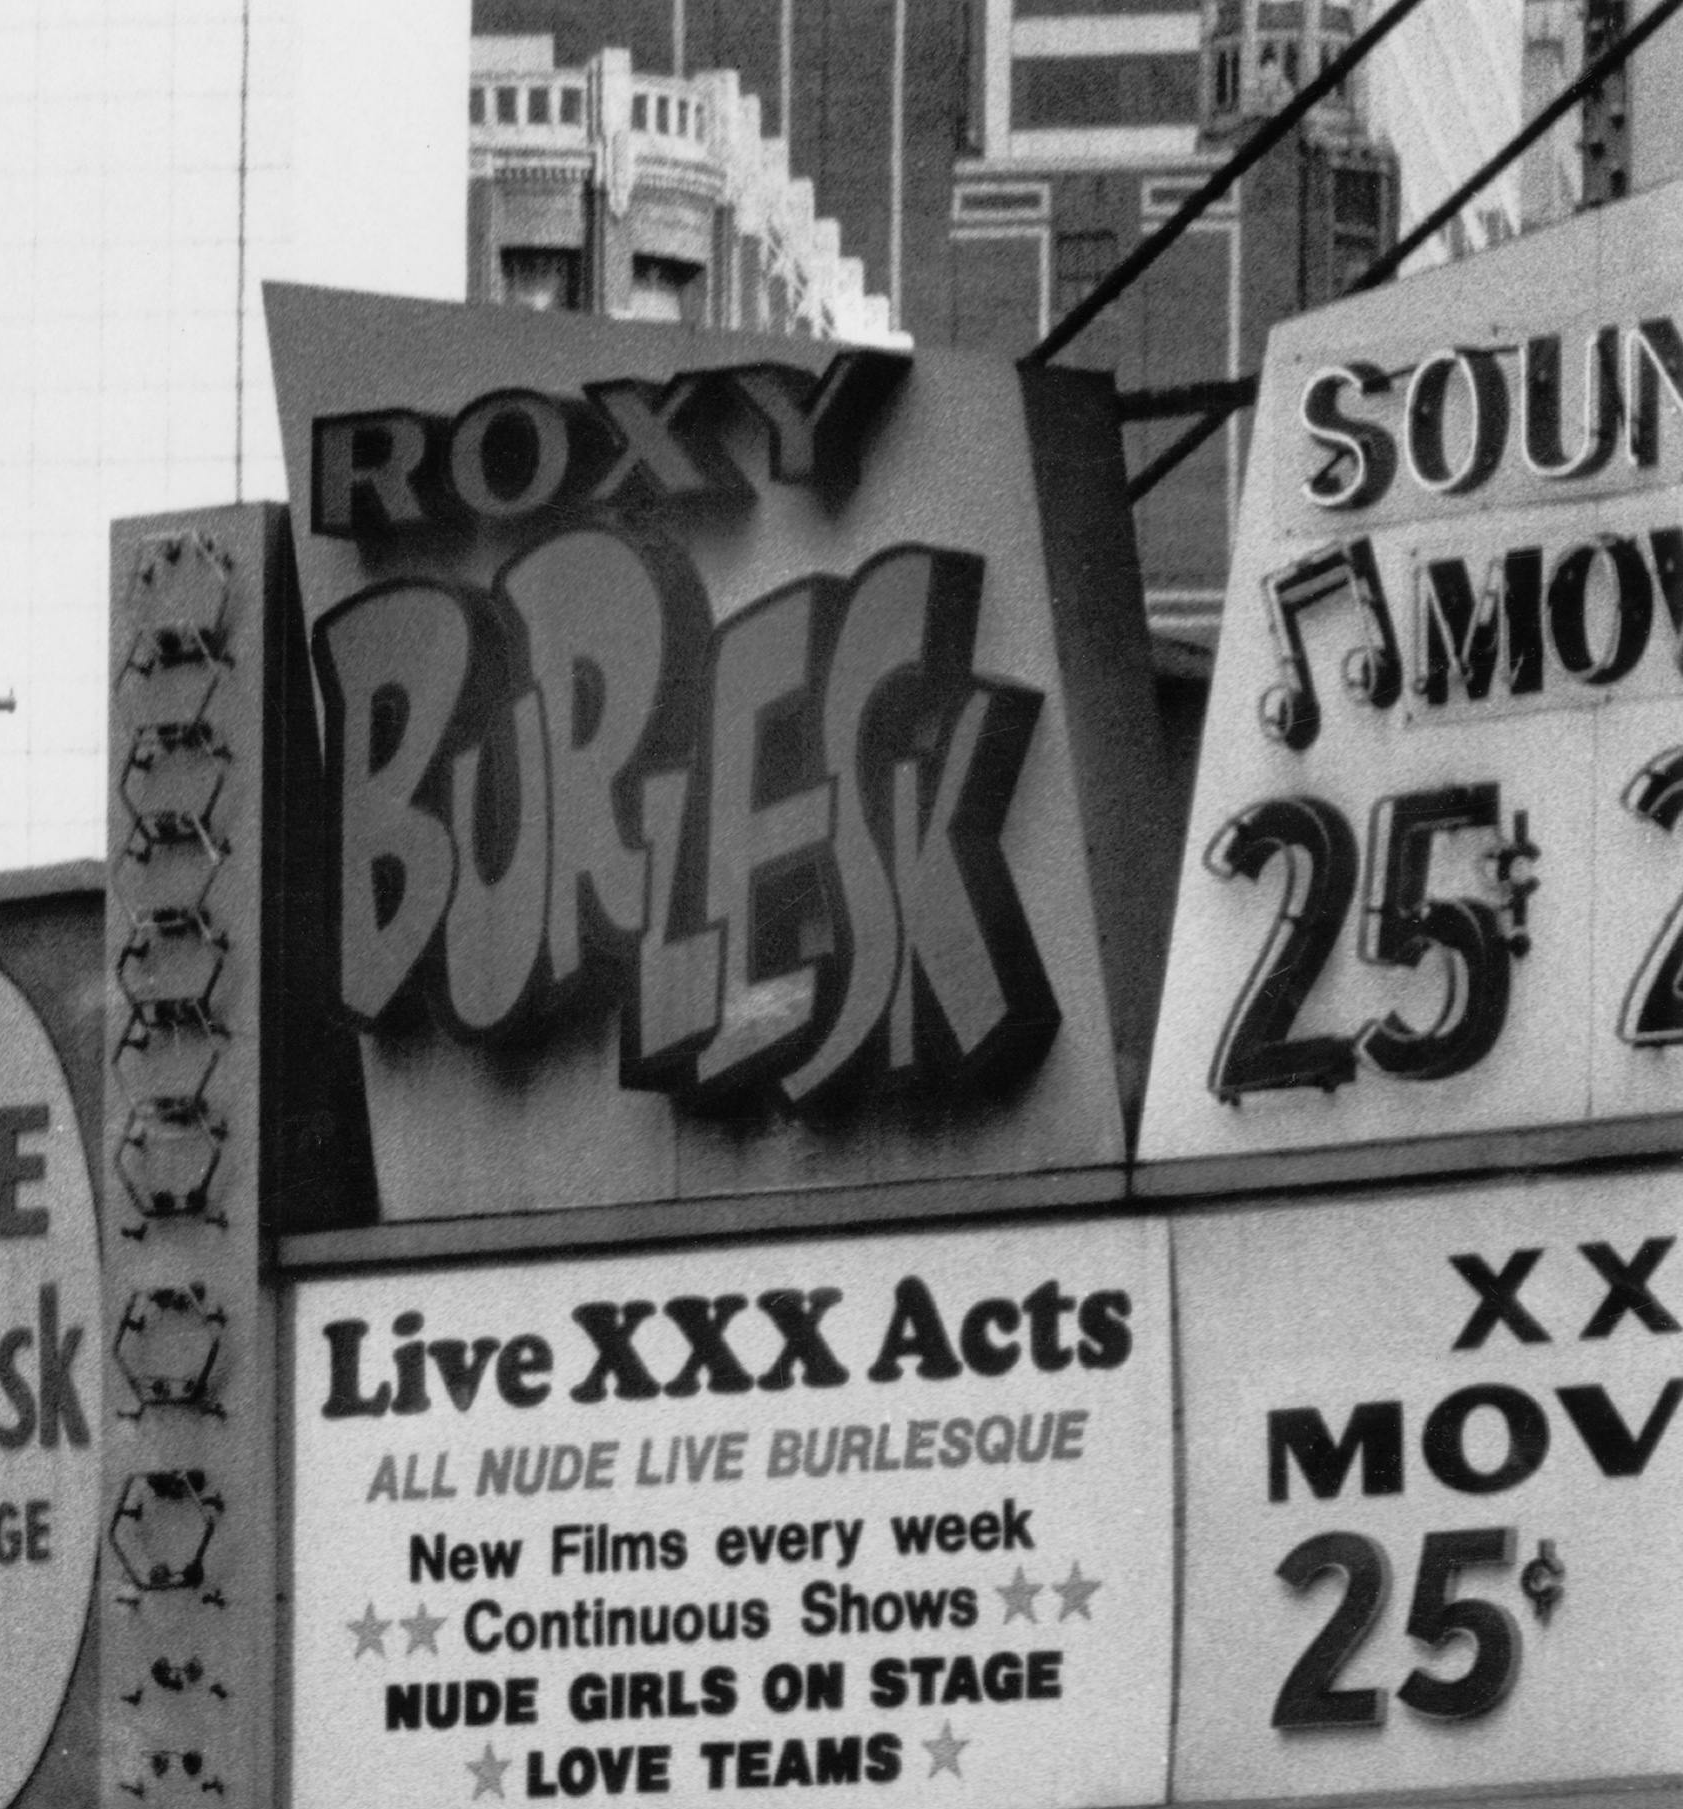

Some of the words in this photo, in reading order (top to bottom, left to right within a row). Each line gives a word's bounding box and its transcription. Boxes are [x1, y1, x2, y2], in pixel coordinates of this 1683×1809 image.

[311, 350, 914, 540] ROXY
[311, 530, 1063, 1100] BURLESK
[321, 1311, 553, 1420] Live
[569, 1287, 848, 1403] XXX
[866, 1274, 1133, 1382] Acts
[366, 1454, 458, 1503] ALL
[476, 1441, 618, 1497] NUDE
[636, 1430, 748, 1485] LIVE
[768, 1409, 1089, 1480] BURLESQUE
[1267, 1377, 1683, 1503] MOV
[409, 1532, 522, 1583] New
[551, 1523, 687, 1577] Films
[715, 1514, 862, 1570] every
[890, 1499, 1034, 1555] week
[463, 1587, 770, 1652] Continuous
[800, 1580, 979, 1634] Shows
[1270, 1526, 1565, 1731] 25¢
[386, 1678, 537, 1731] NUDE
[569, 1666, 737, 1722] GIRLS
[764, 1661, 844, 1709] ON
[869, 1651, 1063, 1708] STAGE
[526, 1745, 670, 1798] LOVE
[701, 1733, 901, 1788] TEAMS
